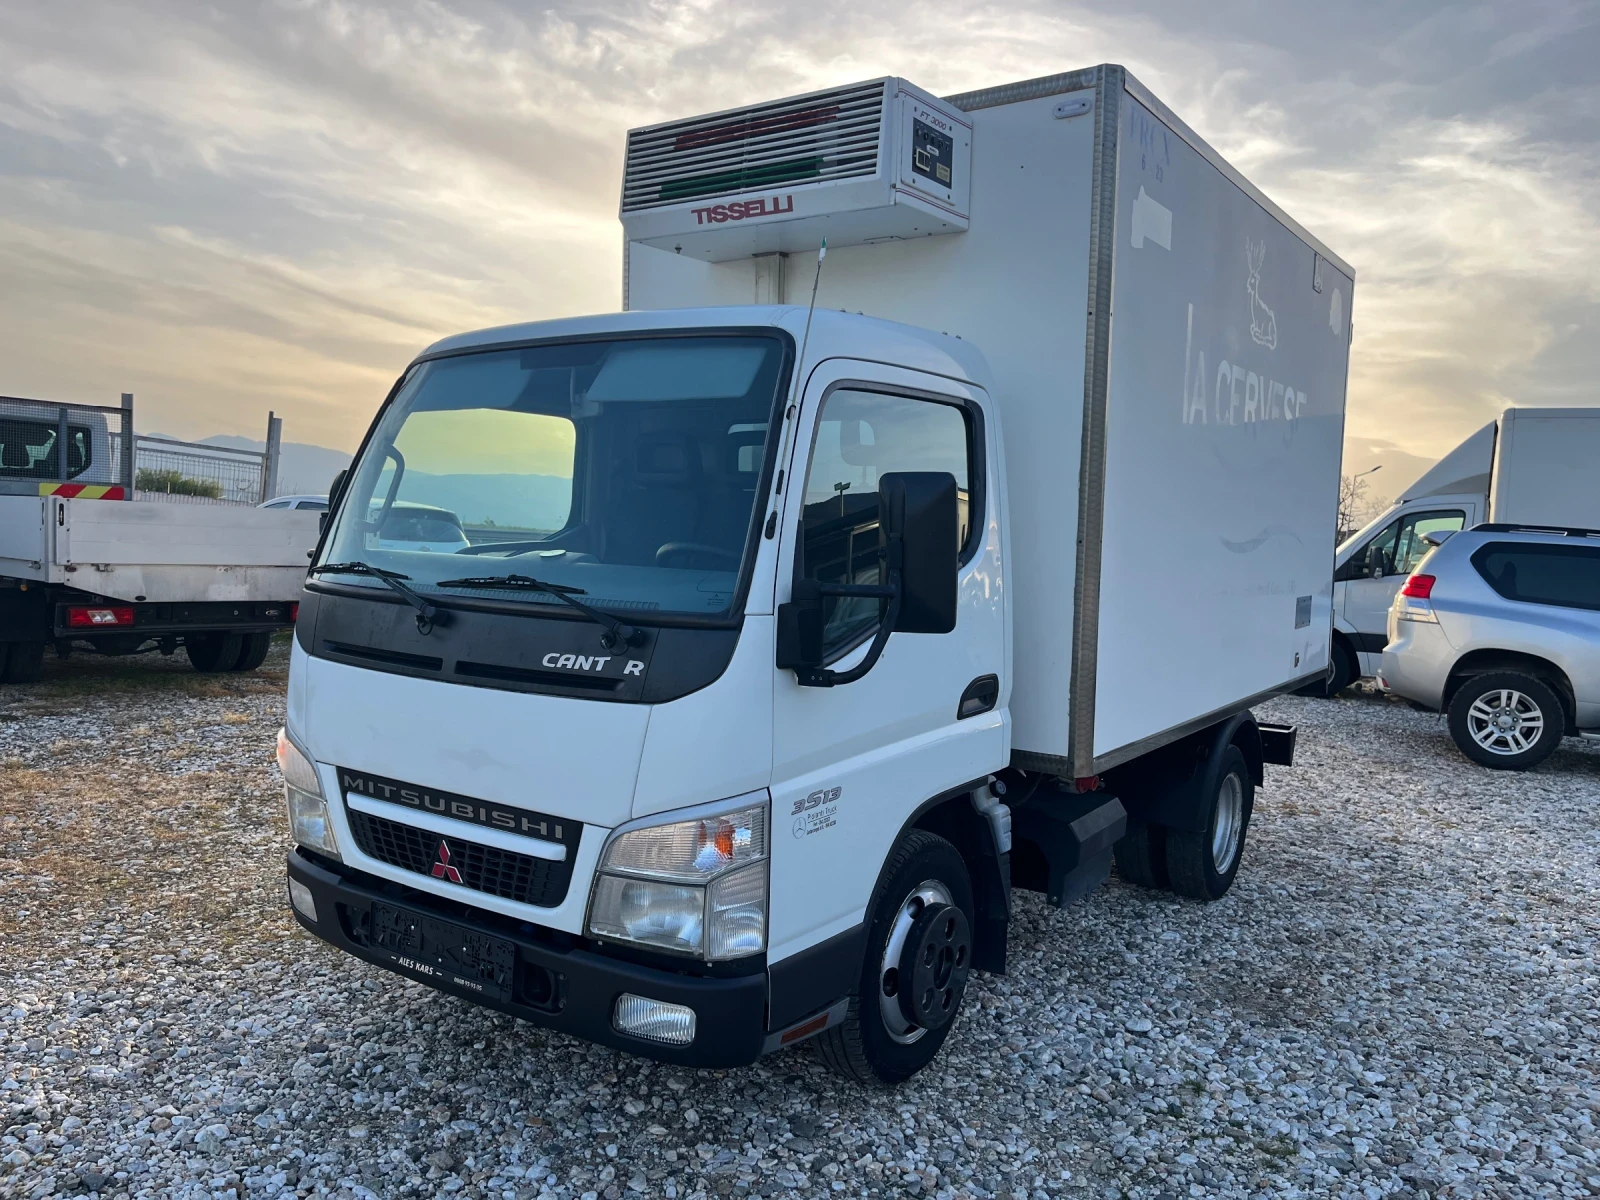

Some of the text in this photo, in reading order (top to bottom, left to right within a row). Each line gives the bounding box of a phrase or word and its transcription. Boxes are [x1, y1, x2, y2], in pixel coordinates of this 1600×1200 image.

[920, 110, 948, 131] FT 3000
[690, 195, 794, 225] TISSELLI
[343, 774, 564, 840] MITSUBISHI
[791, 785, 843, 816] 3S13
[398, 956, 434, 975] ALES KARS
